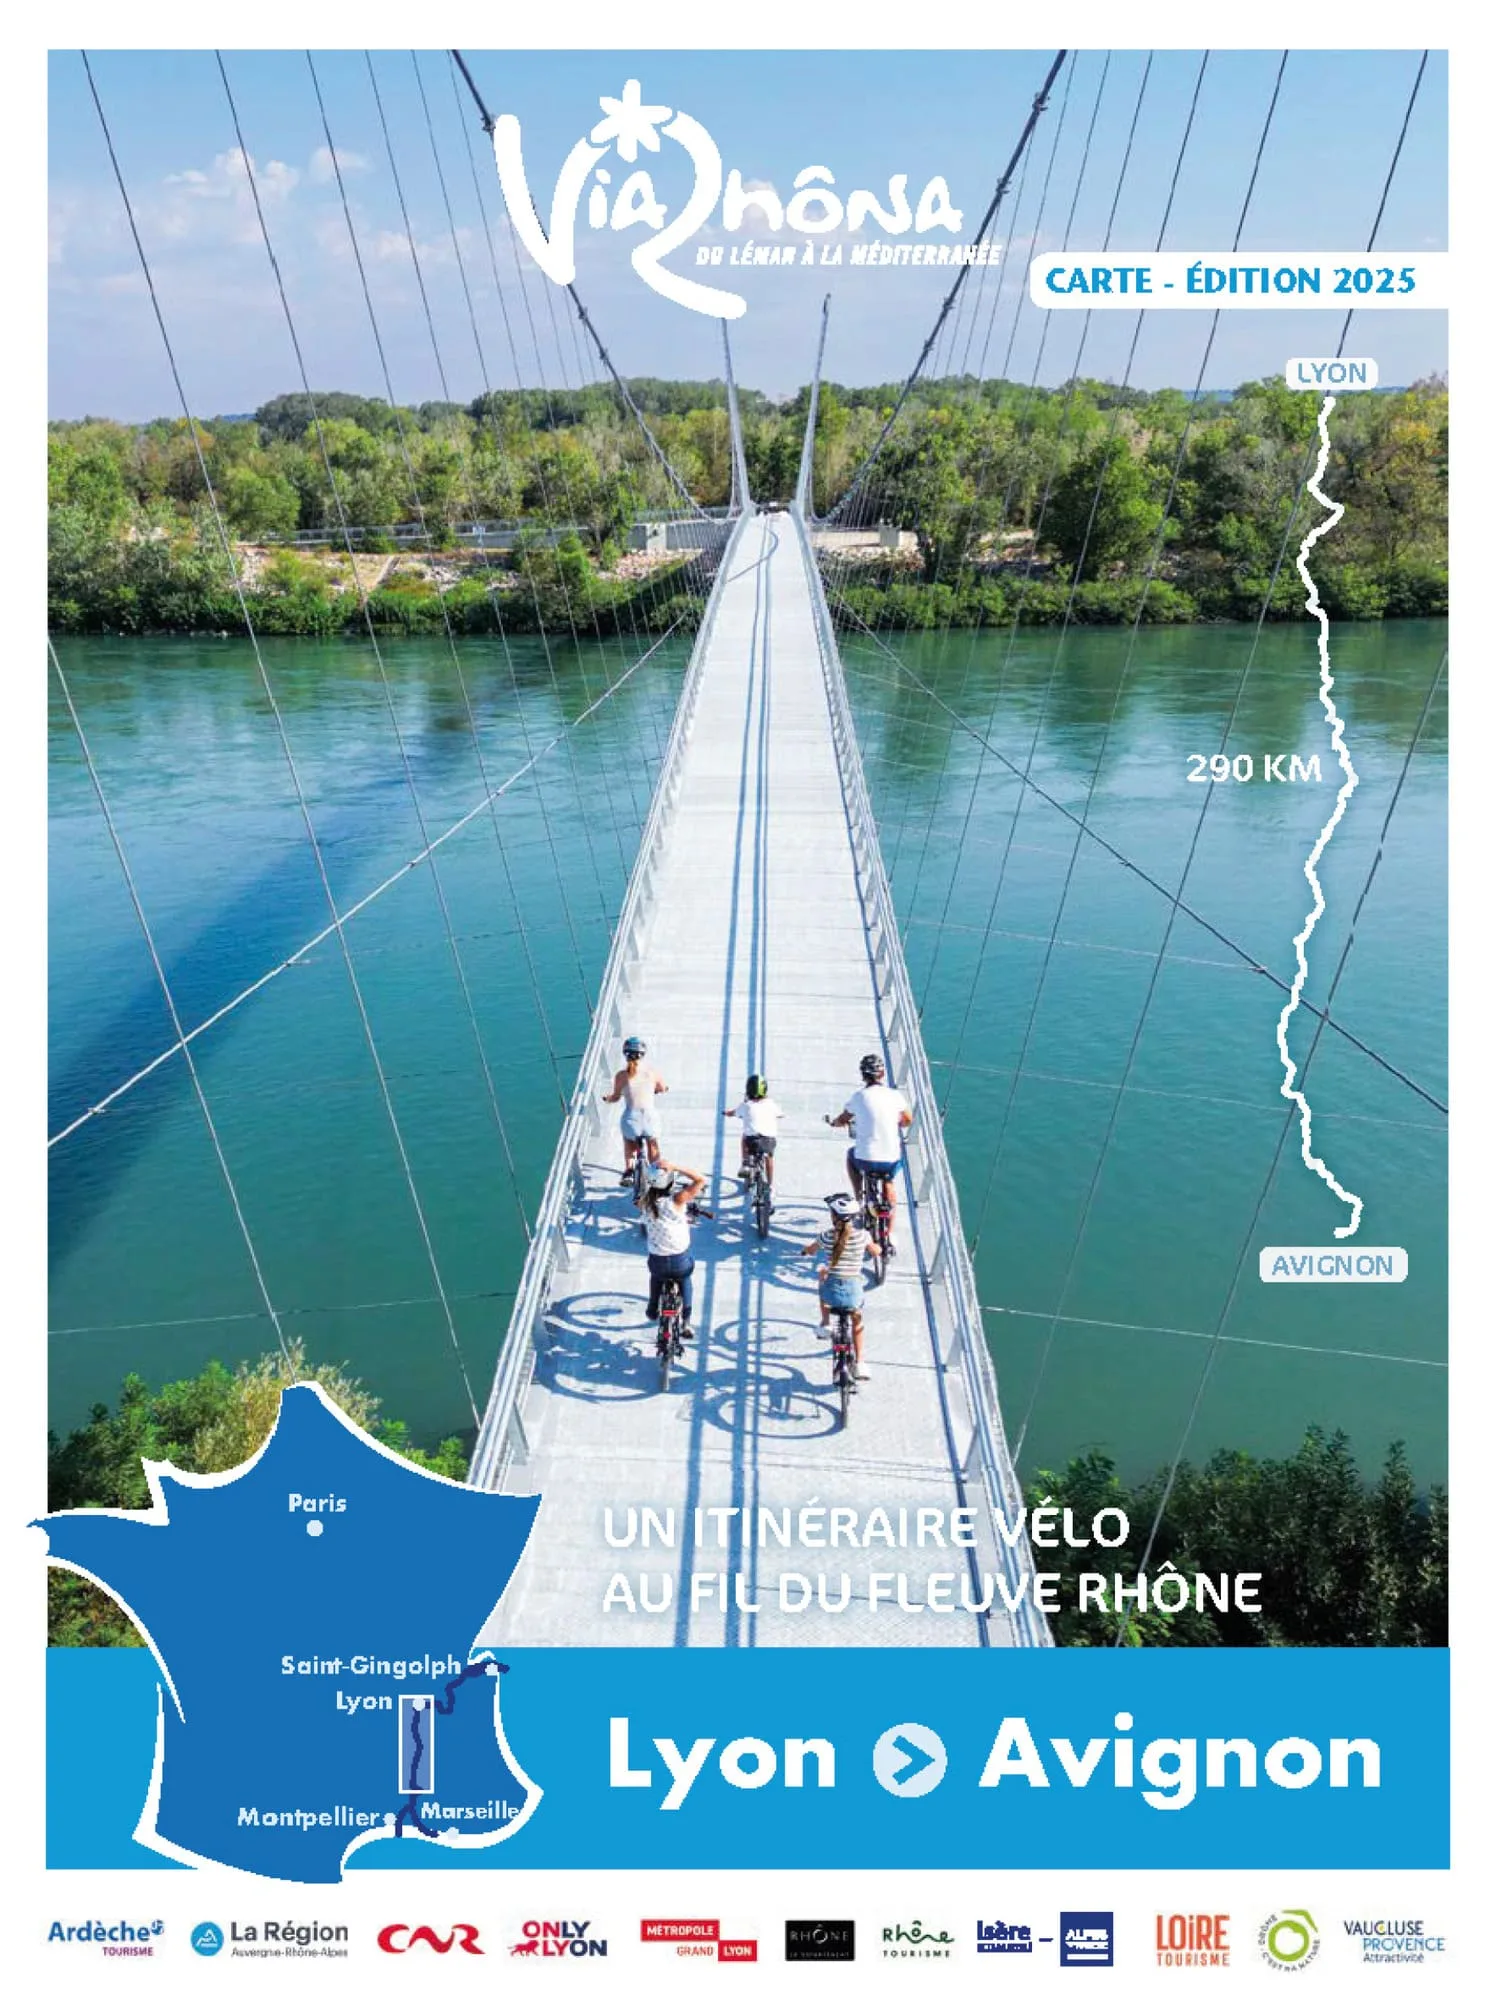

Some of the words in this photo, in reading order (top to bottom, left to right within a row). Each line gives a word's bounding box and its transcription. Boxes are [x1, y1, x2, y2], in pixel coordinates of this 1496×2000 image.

[800, 240, 815, 265] À
[820, 245, 843, 265] LA
[850, 240, 1003, 265] MÉDITERRANÉE
[1045, 267, 1153, 294] CARTE
[1186, 261, 1321, 294] ÉDITION
[1333, 267, 1417, 294] 2025
[1297, 362, 1367, 384] LYON
[1186, 755, 1254, 783] 290
[1263, 755, 1323, 783] KM
[1271, 1254, 1394, 1277] AVIGNON
[288, 1493, 347, 1513] Paris
[603, 1507, 676, 1548] UN
[690, 1498, 979, 1548] ITINÉRAIRE
[992, 1496, 1131, 1548] VÉLO
[602, 1572, 673, 1614] AU
[689, 1572, 762, 1614] FIL
[778, 1572, 852, 1614] DU
[867, 1572, 1061, 1614] FLEUVE
[1078, 1560, 1264, 1614] RHÔNE
[281, 1654, 462, 1679] Saint-Gingolph
[336, 1691, 393, 1714] Lyon
[609, 1717, 837, 1811] Lyon
[978, 1711, 1382, 1811] Avignon
[237, 1806, 379, 1831] Montpellier
[420, 1801, 519, 1820] Marseille
[48, 1919, 150, 1942] Ardèche
[230, 1921, 257, 1942] La
[264, 1920, 348, 1946] Région
[522, 1920, 590, 1938] ONLY
[883, 1920, 954, 1944] Rhône
[1344, 1920, 1424, 1936] VAUCLUSE
[102, 1946, 154, 1957] TOURISME
[542, 1939, 608, 1957] LYON
[676, 1946, 714, 1957] GRAND
[724, 1944, 753, 1958] LYON
[883, 1950, 950, 1958] TOURISME
[1363, 1937, 1446, 1951] PROVENCE
[1156, 1952, 1230, 1967] TOURISME
[1363, 1951, 1425, 1964] Attractivité
